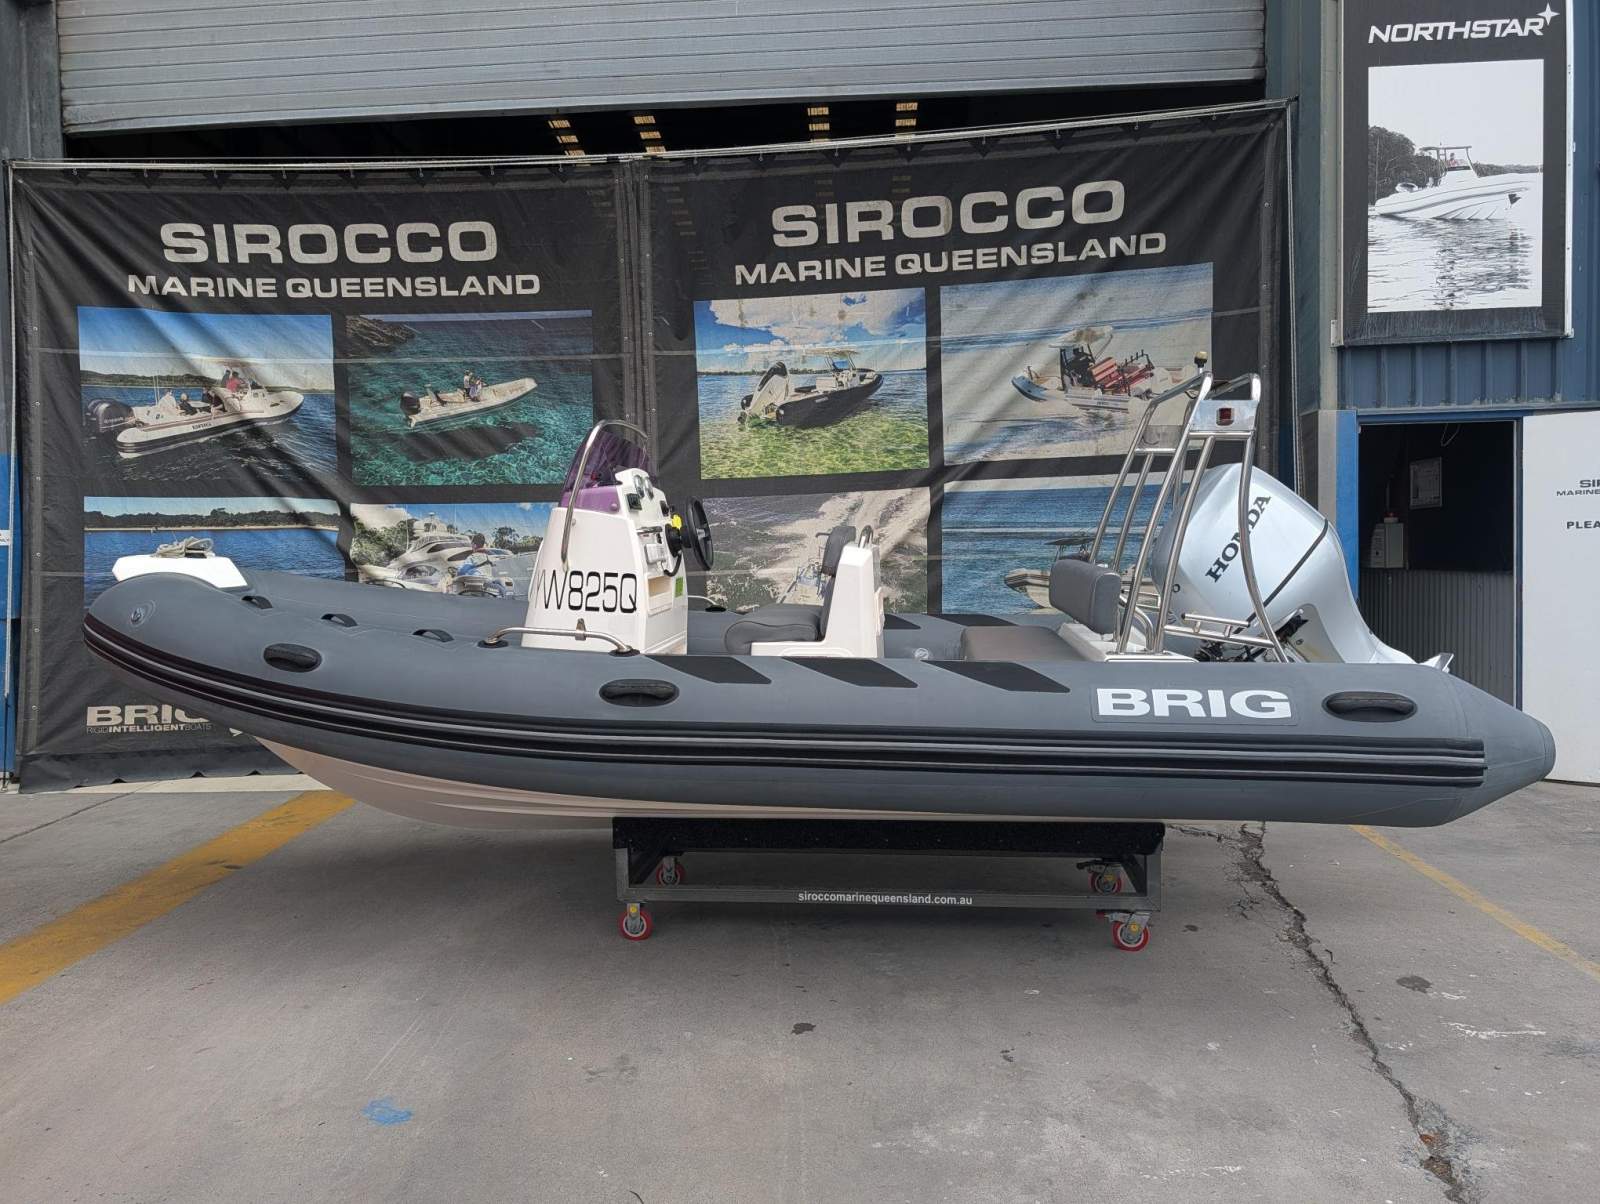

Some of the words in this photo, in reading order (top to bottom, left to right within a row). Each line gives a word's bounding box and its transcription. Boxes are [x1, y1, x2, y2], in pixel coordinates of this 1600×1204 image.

[1368, 18, 1544, 43] NORTHSTAR
[772, 180, 1125, 248] SIROCCO
[161, 221, 498, 264] SIROCCO
[735, 256, 886, 285] MARINE
[895, 232, 1167, 275] QUEENSLAND
[127, 275, 278, 298] MARINE
[286, 274, 540, 298] QUEENSLAND
[1096, 688, 1291, 719] BRIG
[798, 890, 973, 905] siroccomarinequeensland.com.au
